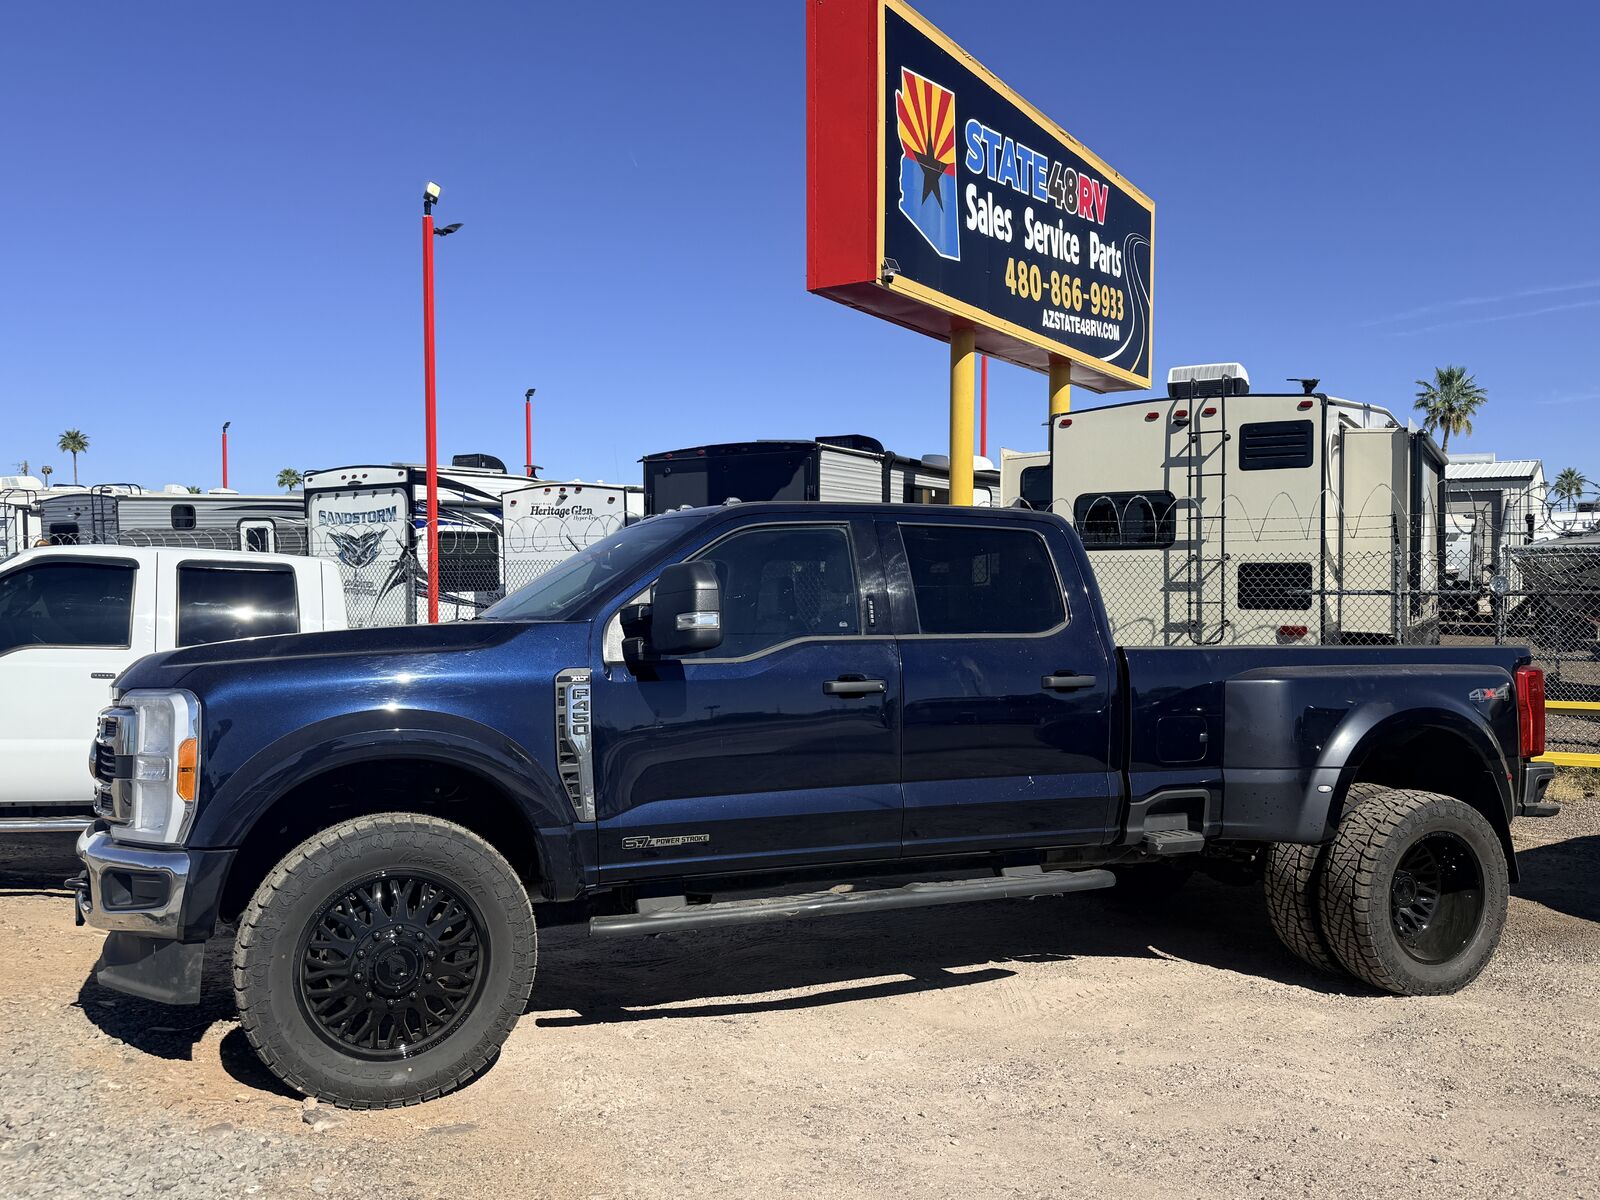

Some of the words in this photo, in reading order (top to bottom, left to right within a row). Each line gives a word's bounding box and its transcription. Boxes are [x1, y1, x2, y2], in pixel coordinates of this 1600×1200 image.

[965, 118, 1109, 225] STATE48RV
[965, 183, 1013, 243] Sales
[1024, 206, 1080, 266] Service
[1089, 230, 1122, 278] Parts
[1005, 257, 1124, 321] 480-866-9933
[1042, 308, 1120, 341] AZSTATE48RV.COM
[318, 505, 397, 525] SANDSTORM
[530, 505, 570, 518] Heritage
[571, 505, 593, 515] Glen
[570, 675, 589, 683] XLT
[572, 688, 590, 736] F450
[656, 837, 680, 846] POWER
[681, 834, 708, 843] STROKE
